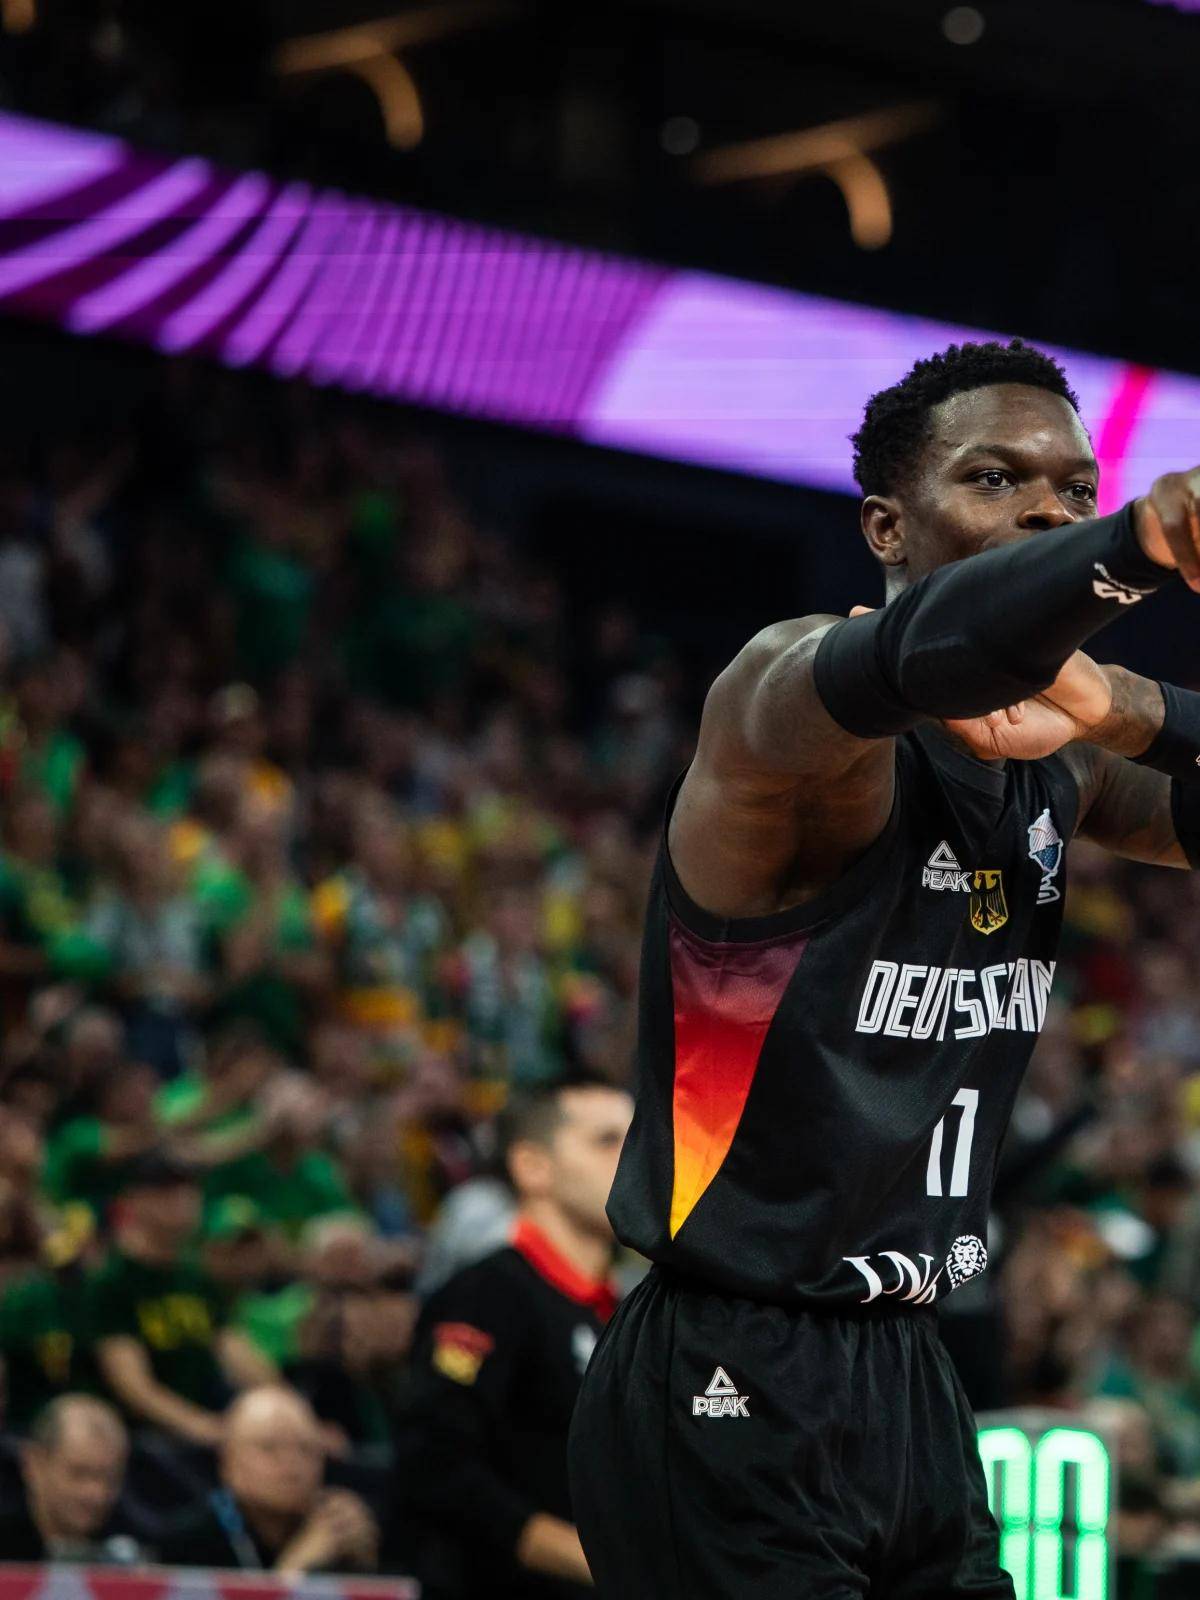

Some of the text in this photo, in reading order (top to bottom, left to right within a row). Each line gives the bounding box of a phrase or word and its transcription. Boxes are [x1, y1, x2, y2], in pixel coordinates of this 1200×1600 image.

[922, 866, 972, 892] PEAK
[926, 1088, 979, 1197] 11
[693, 1396, 750, 1417] PEAK
